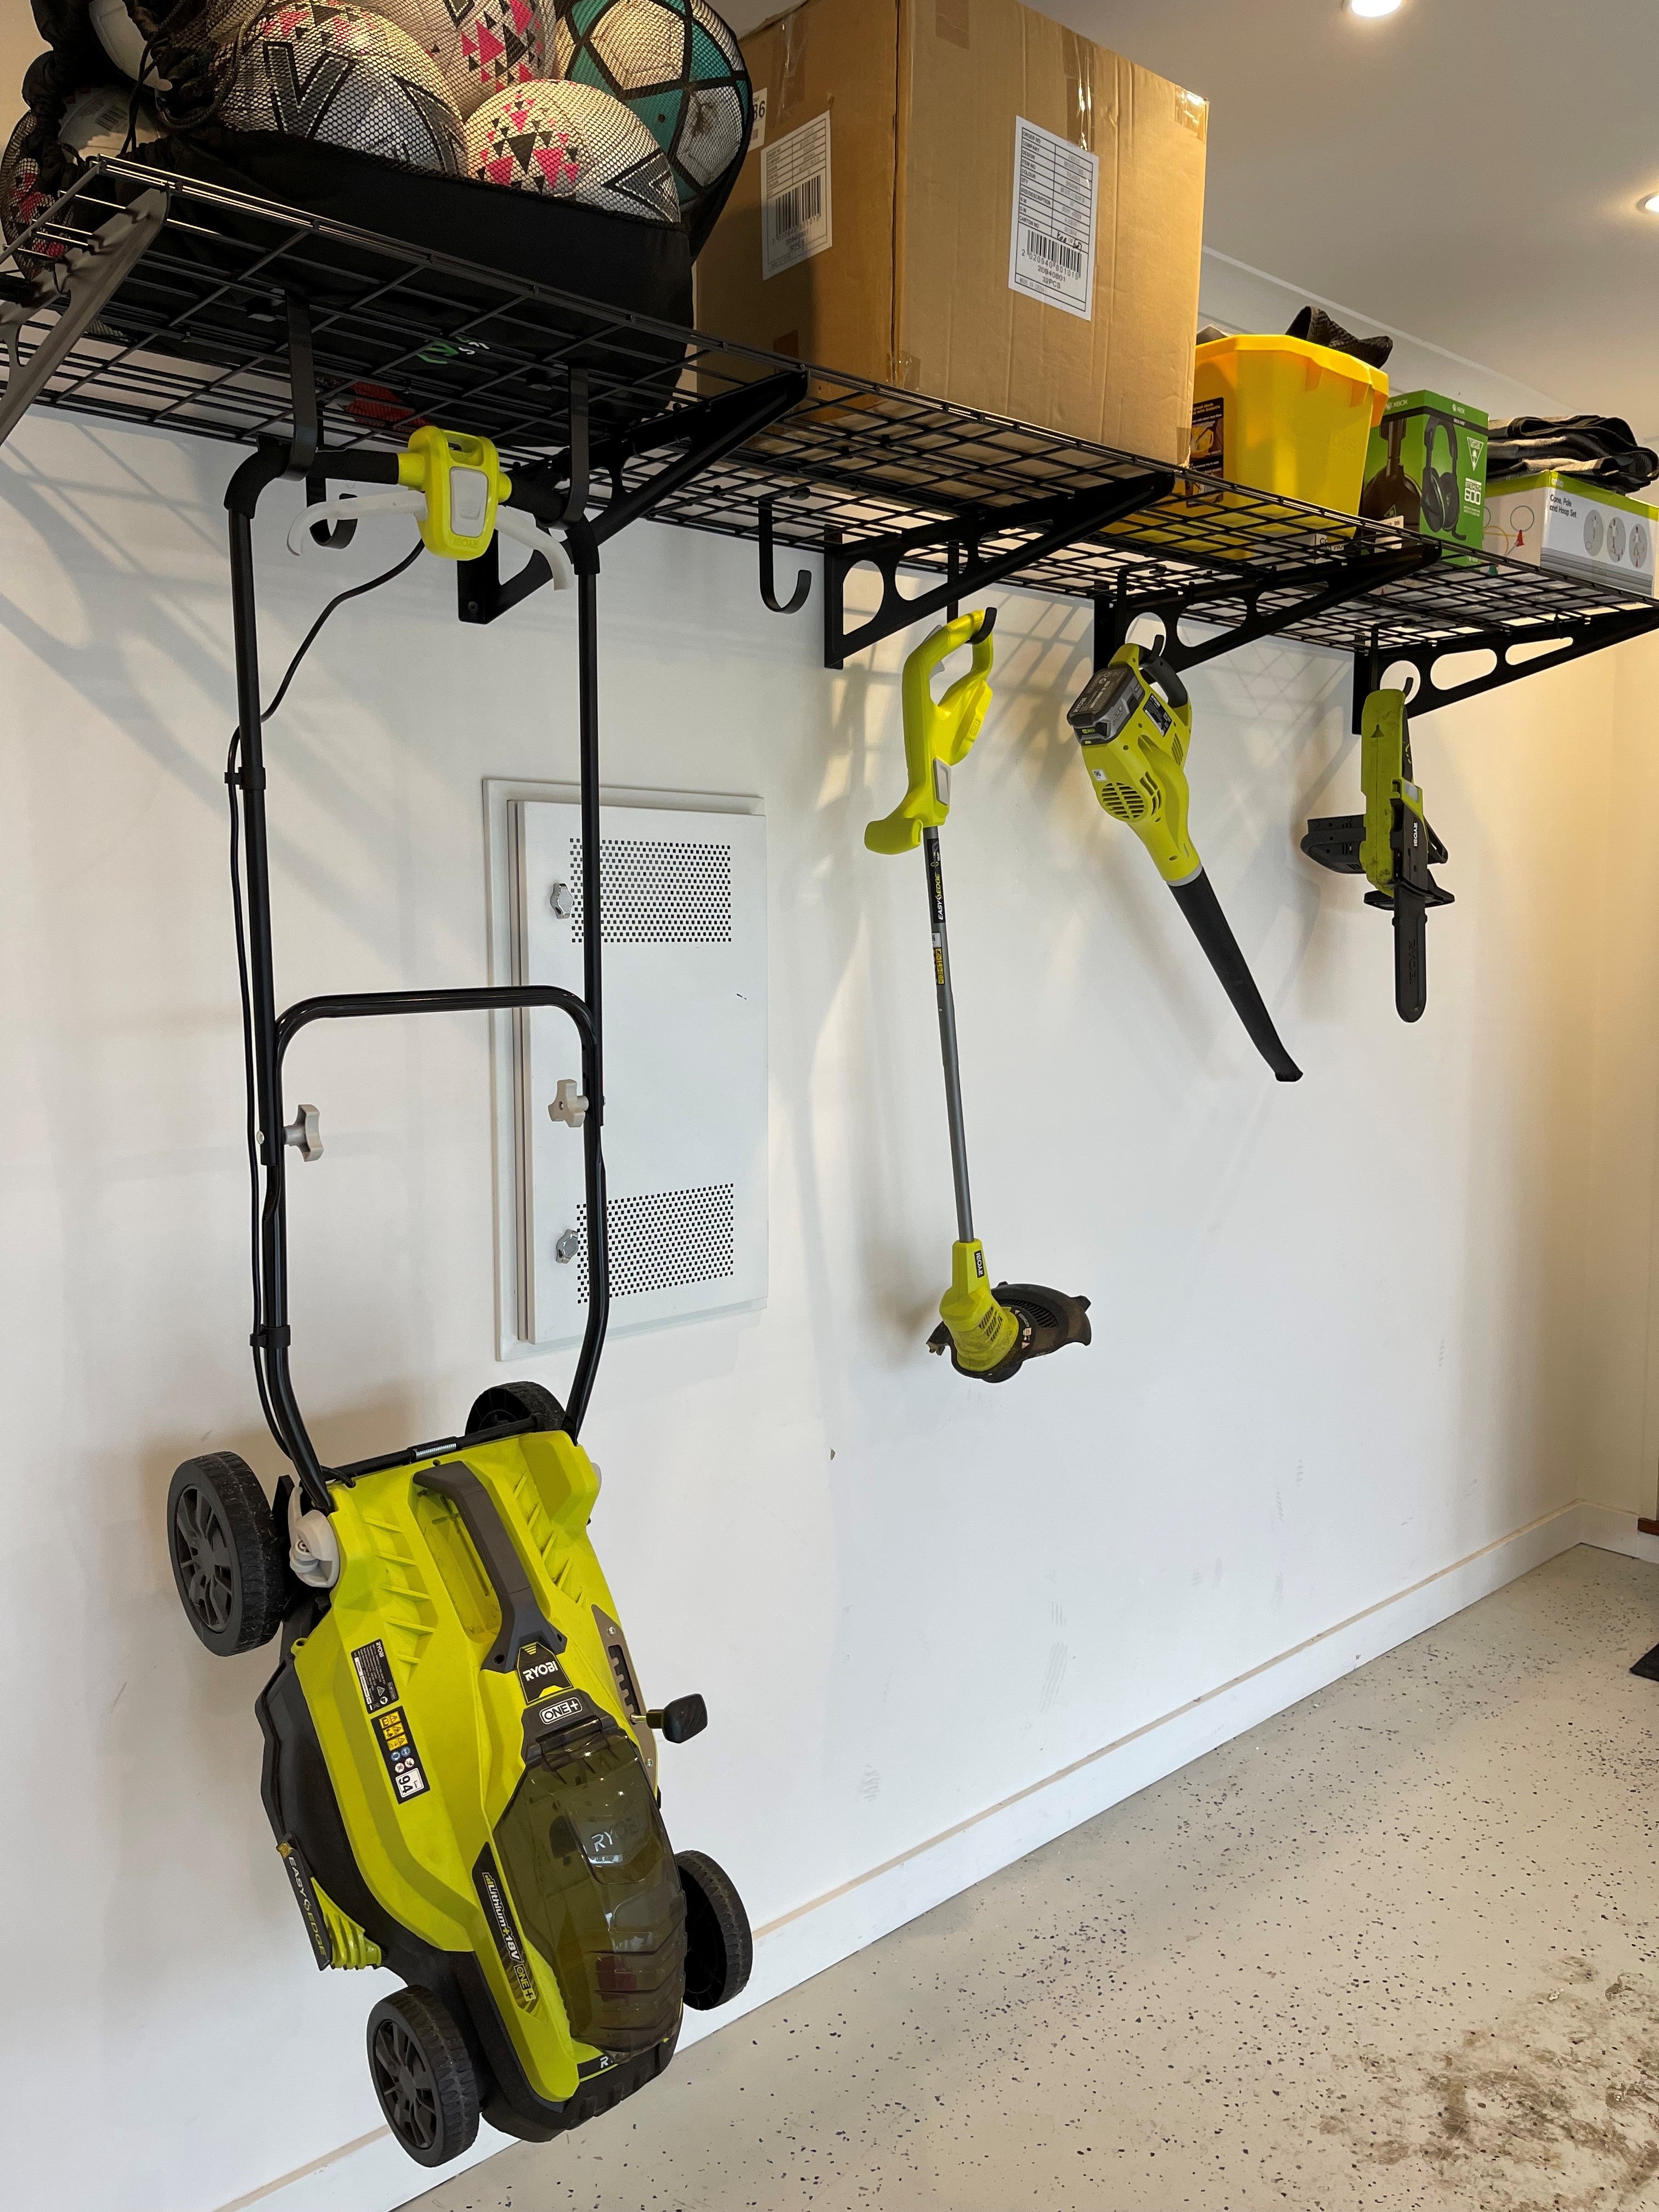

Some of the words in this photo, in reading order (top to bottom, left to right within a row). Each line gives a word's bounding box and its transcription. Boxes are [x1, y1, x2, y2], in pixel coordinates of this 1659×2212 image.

[1038, 266, 1066, 282] 20940801
[1393, 399, 1408, 408] XBOX
[1464, 487, 1481, 505] 600
[1465, 482, 1481, 492] STEALTH
[376, 1641, 384, 1658] RYOBI
[523, 1661, 558, 1681] RYOBI
[544, 1700, 579, 1720] ONE+
[399, 1775, 413, 1793] 94
[289, 1857, 307, 1898] EASY
[307, 1912, 327, 1956] EDGE
